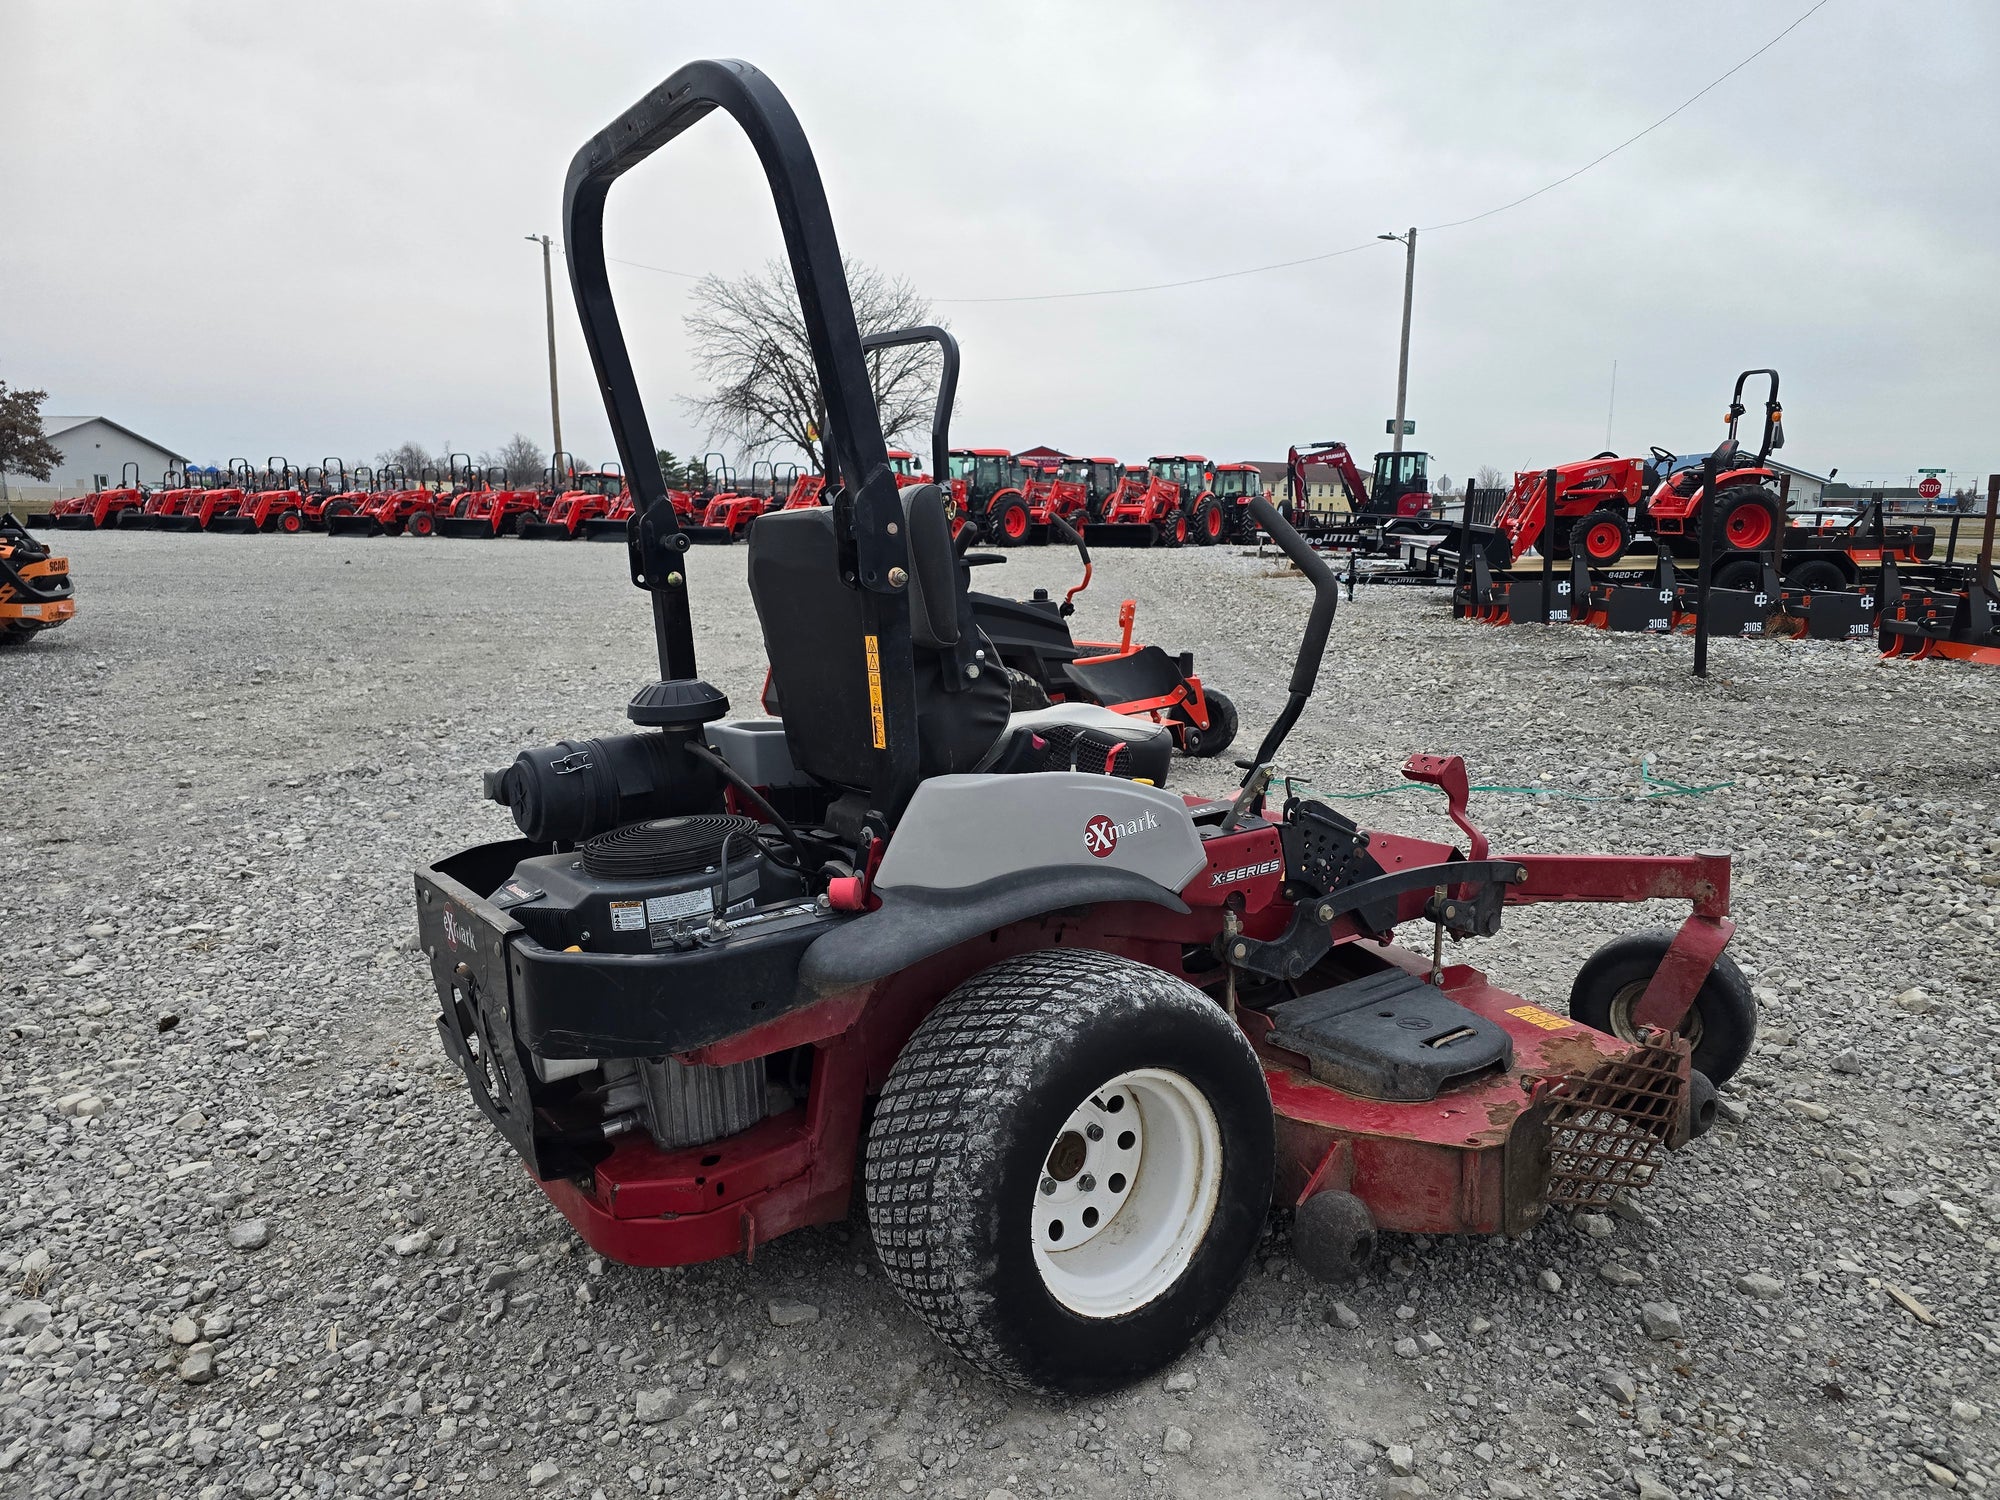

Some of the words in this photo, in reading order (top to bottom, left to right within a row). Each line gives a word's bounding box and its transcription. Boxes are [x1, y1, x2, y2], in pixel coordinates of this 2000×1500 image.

[1919, 484, 1941, 493] STOP
[1323, 533, 1360, 543] LITTLE
[49, 560, 66, 572] SCAG
[1549, 610, 1568, 620] 310S
[1648, 619, 1668, 629] 310S
[1743, 622, 1763, 632] 310S
[1849, 623, 1869, 634] 310S
[1211, 859, 1281, 886] X-SERIES
